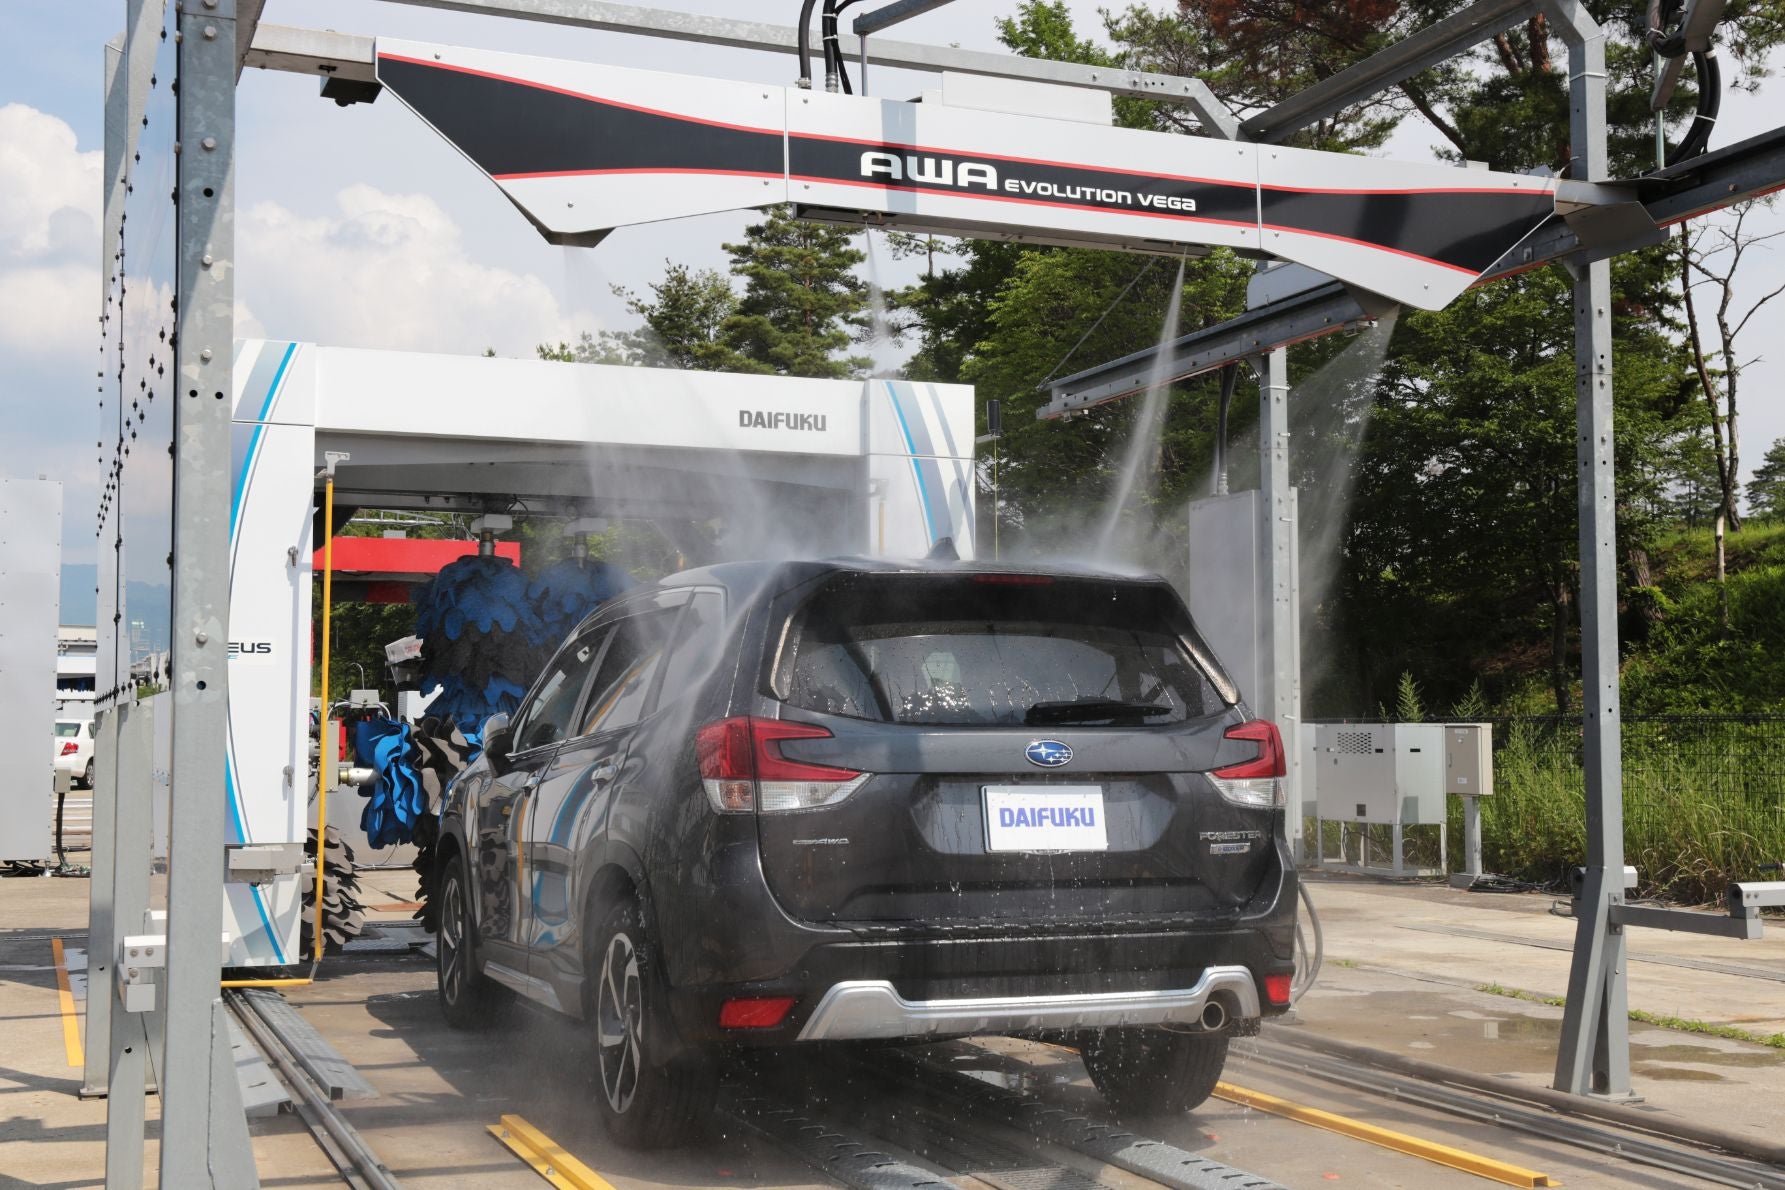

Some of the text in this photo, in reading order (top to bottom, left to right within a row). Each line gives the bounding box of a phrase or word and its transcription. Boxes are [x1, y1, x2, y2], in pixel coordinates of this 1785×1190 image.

[860, 151, 1196, 211] AWA EVOLUTION VEGA
[739, 410, 827, 432] DAIFUKU
[999, 807, 1096, 828] DAIFUKU
[1199, 830, 1261, 841] FORESTER
